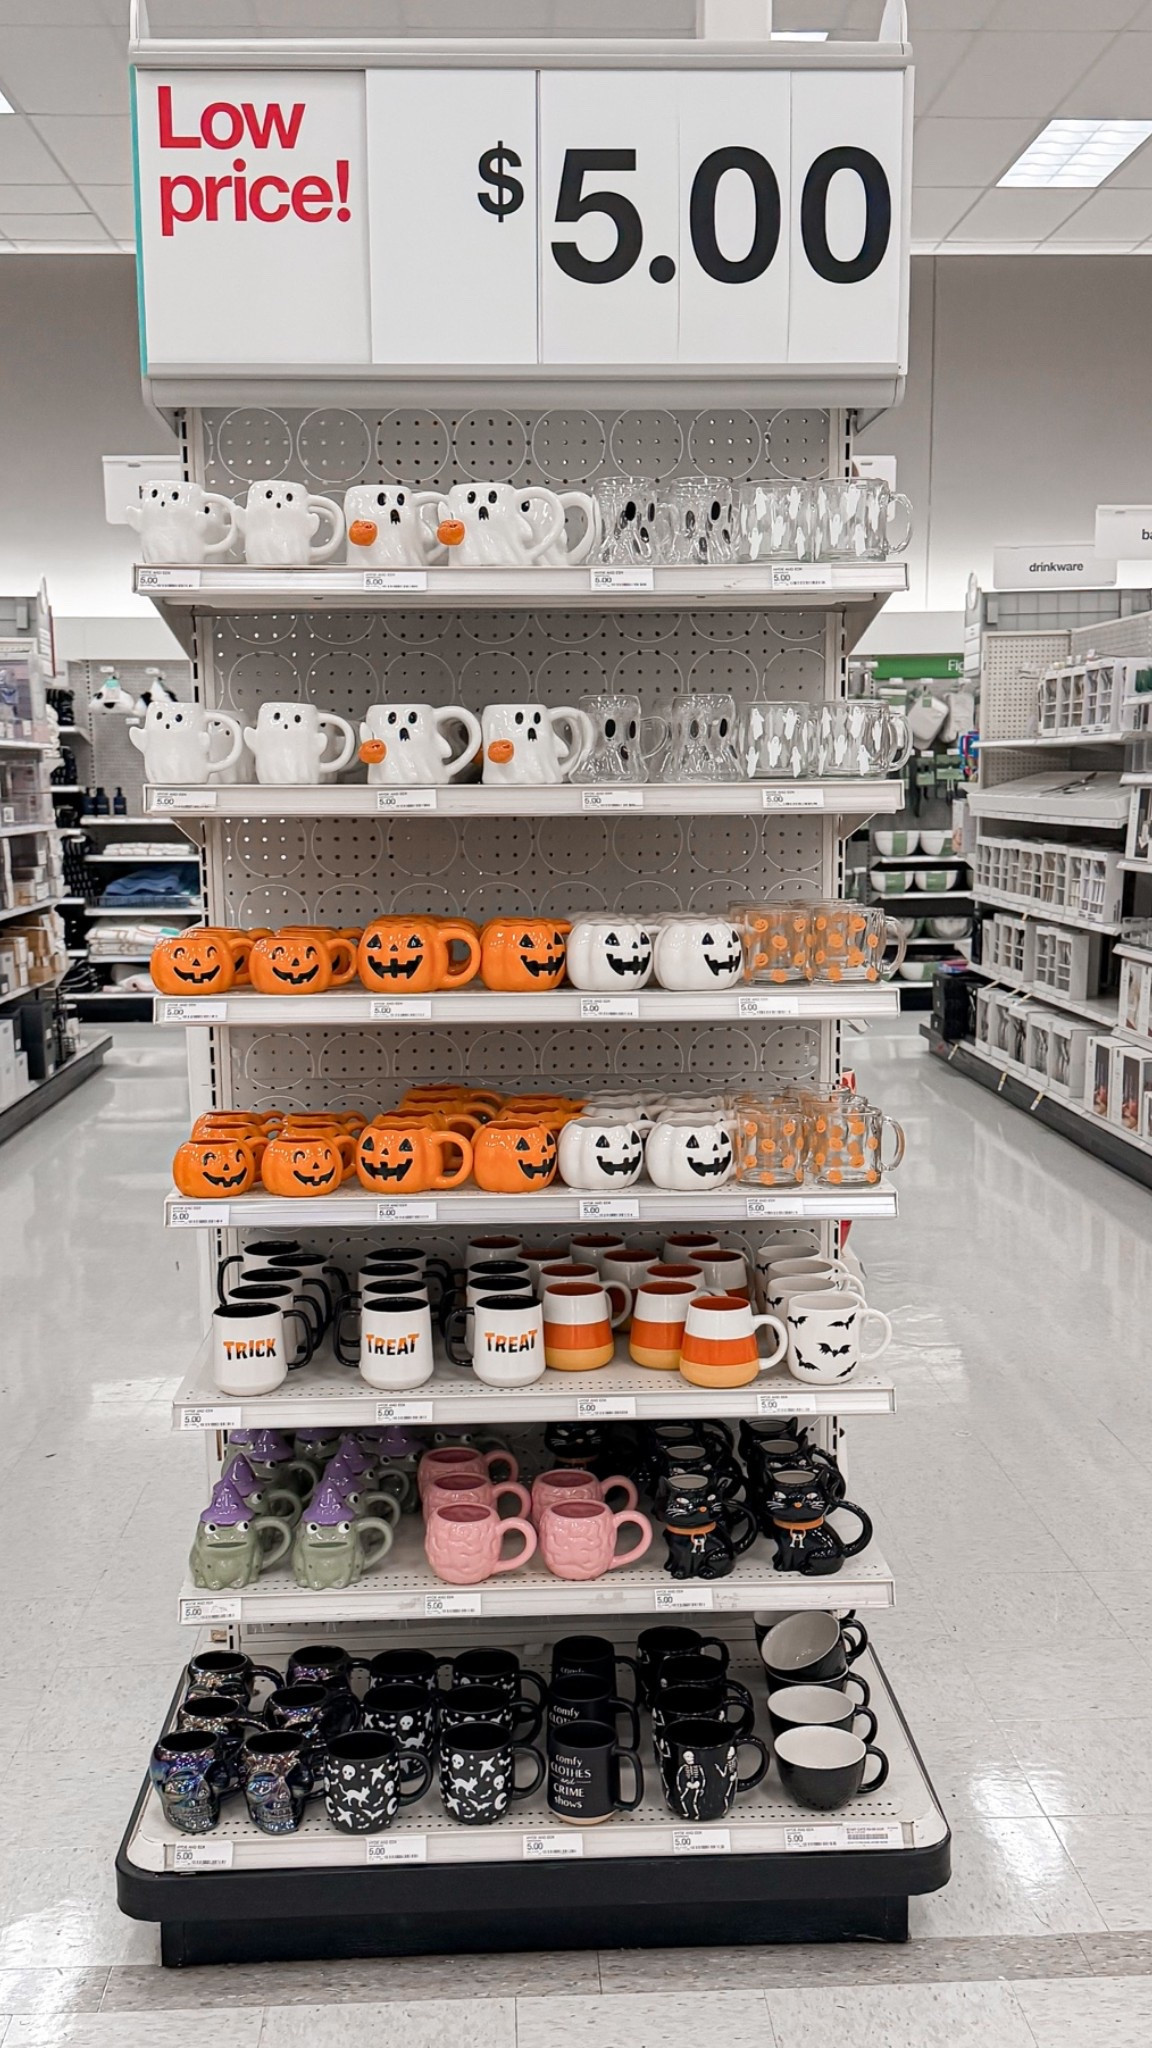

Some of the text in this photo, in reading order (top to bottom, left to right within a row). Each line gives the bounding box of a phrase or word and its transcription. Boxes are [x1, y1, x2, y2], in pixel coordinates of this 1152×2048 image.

[158, 85, 305, 150] Low
[160, 158, 352, 237] price!
[1029, 562, 1084, 573] drinkware
[740, 1003, 757, 1011] 5.00
[379, 1208, 396, 1216] 5.00
[365, 1333, 420, 1355] TREAT
[484, 1329, 538, 1353] TREAT
[223, 1338, 276, 1360] TRICK
[657, 1596, 673, 1604] 5.00
[553, 1705, 580, 1719] comfy
[555, 1754, 583, 1768] comfy
[550, 1761, 592, 1779] CLOTHES
[553, 1782, 585, 1798] CRIME
[554, 1795, 583, 1808] shows
[369, 1847, 386, 1855] 5.00
[527, 1842, 544, 1850] 5.00
